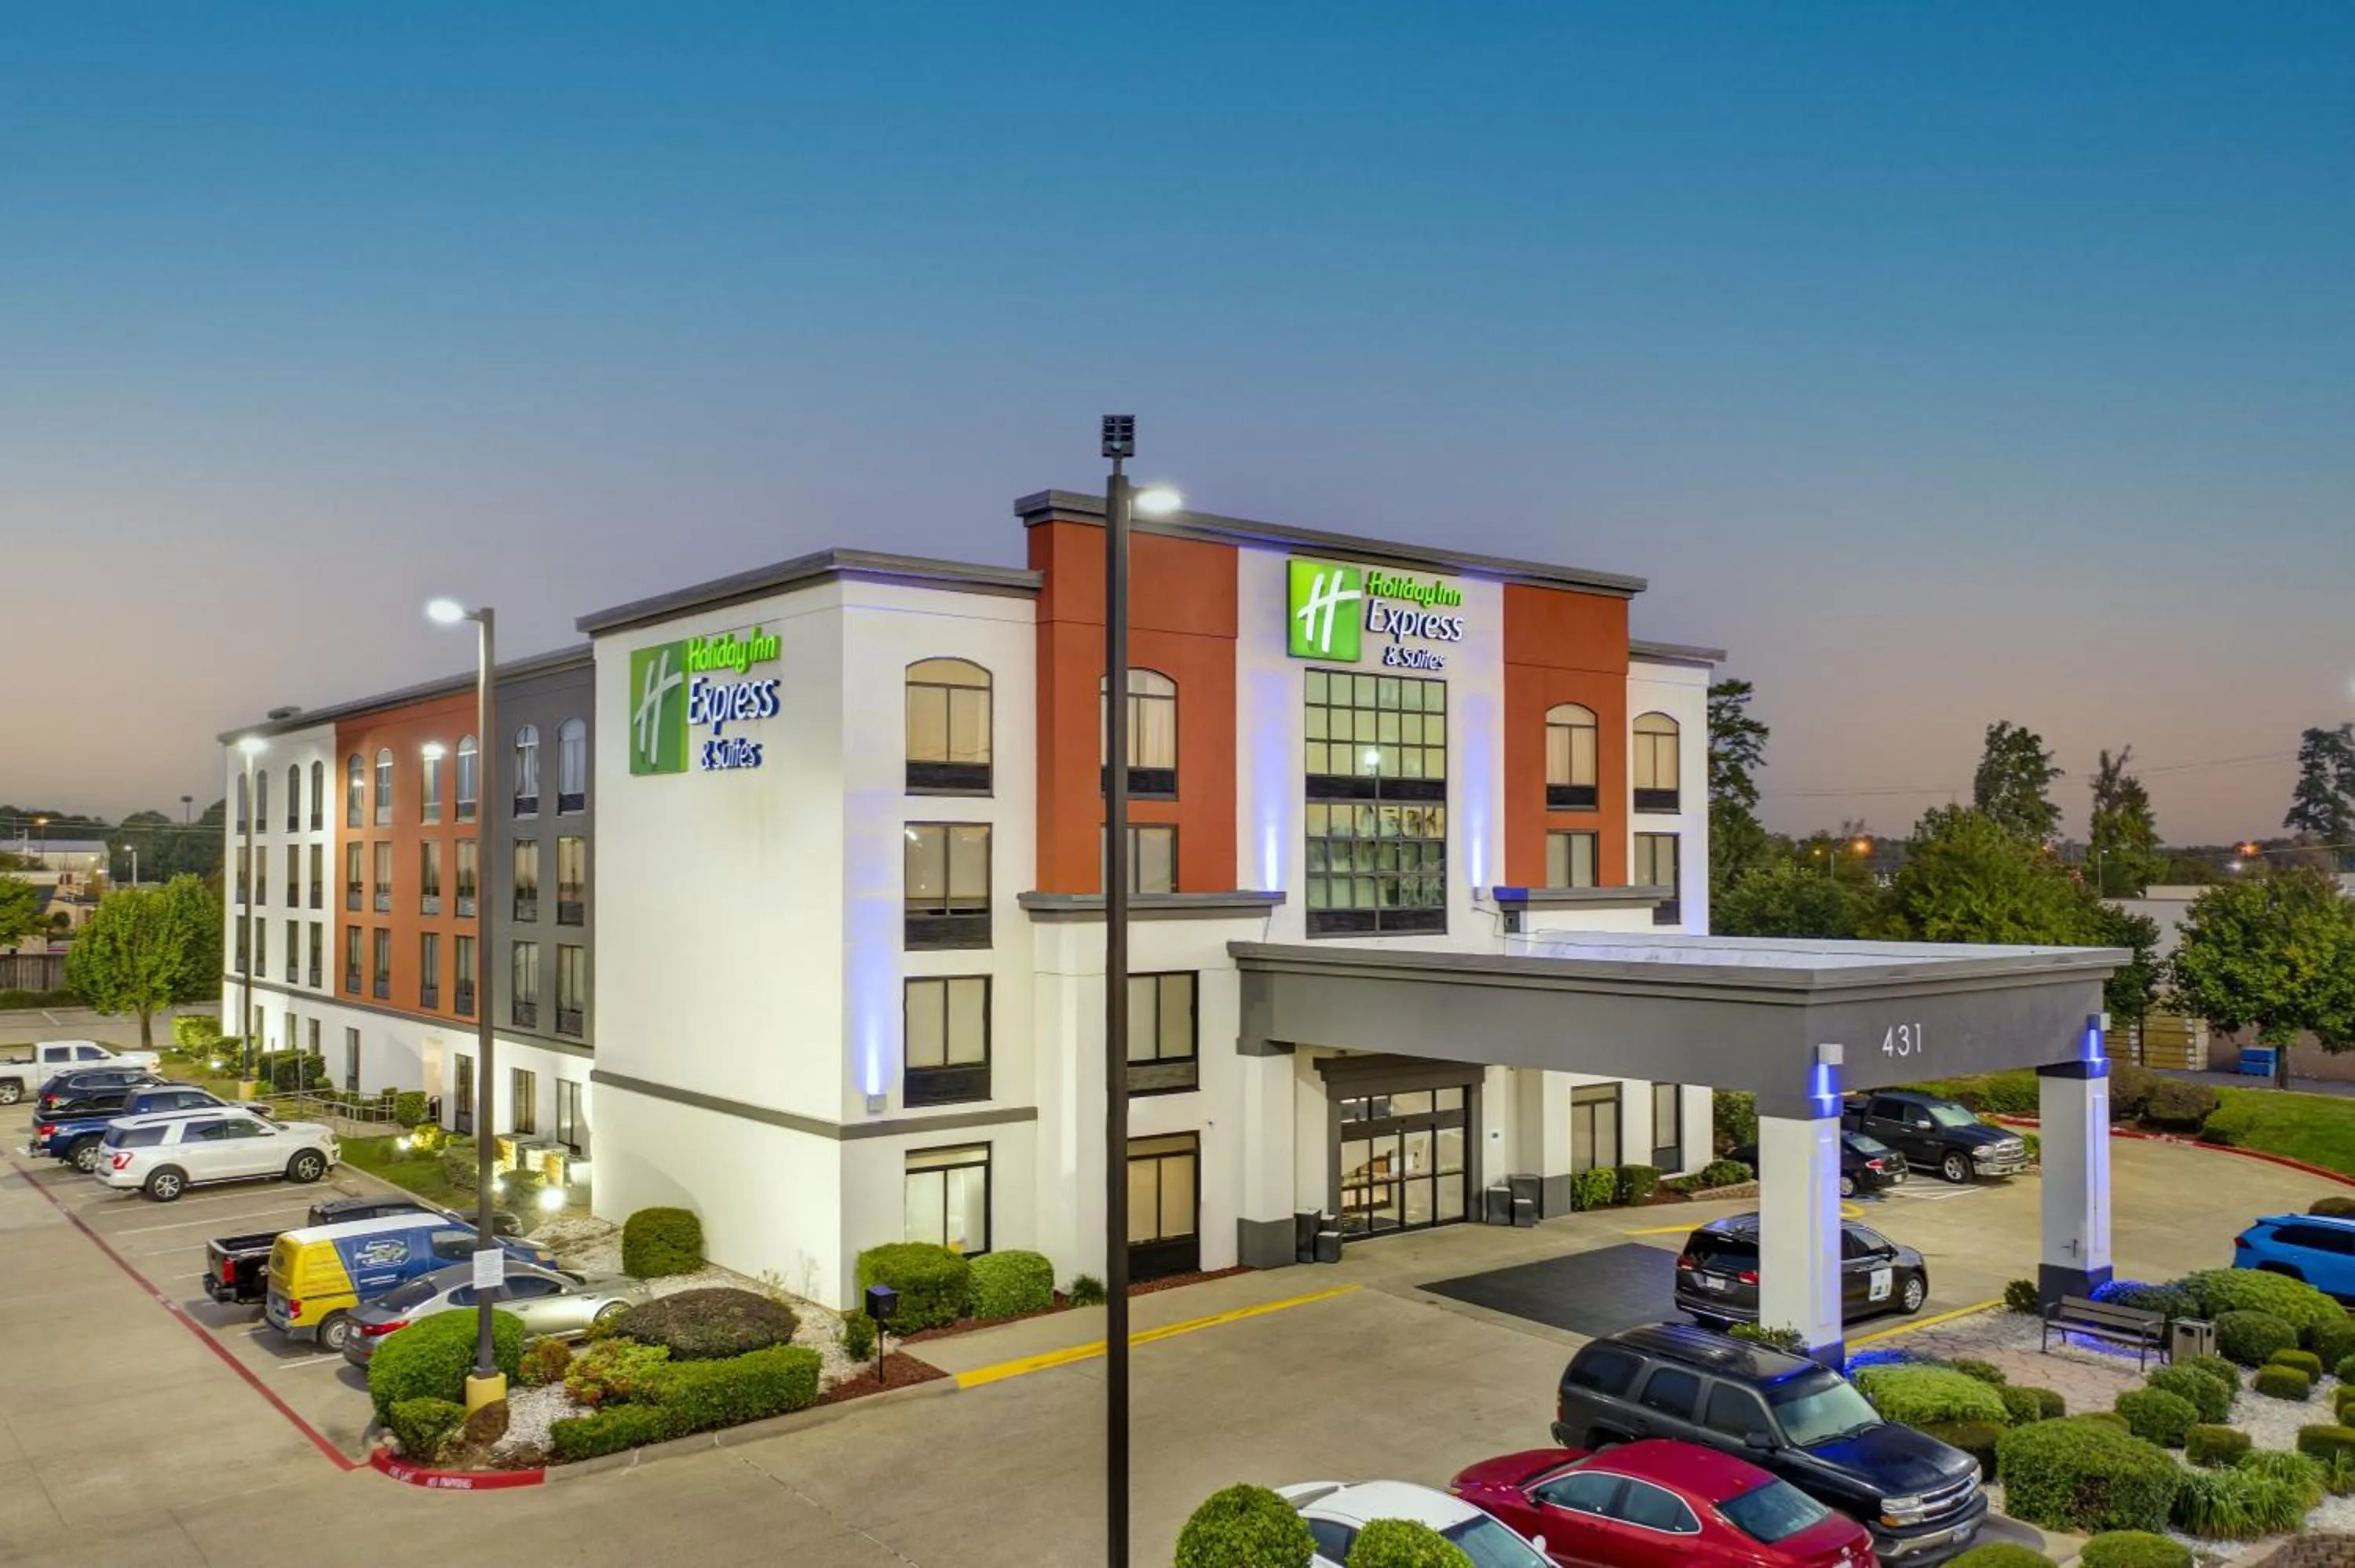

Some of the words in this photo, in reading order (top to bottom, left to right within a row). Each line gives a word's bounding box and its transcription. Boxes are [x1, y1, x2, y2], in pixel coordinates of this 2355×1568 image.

[1366, 571, 1435, 608] Holiday
[1436, 581, 1462, 606] Inn
[1366, 599, 1464, 644] Express
[688, 633, 751, 673] Holiday
[750, 626, 780, 662] Inn
[1383, 646, 1397, 665] &
[1398, 647, 1446, 670] Suites
[688, 677, 780, 735] Express
[702, 741, 717, 769] &
[716, 738, 763, 768] Suites
[1882, 1023, 1921, 1057] 431
